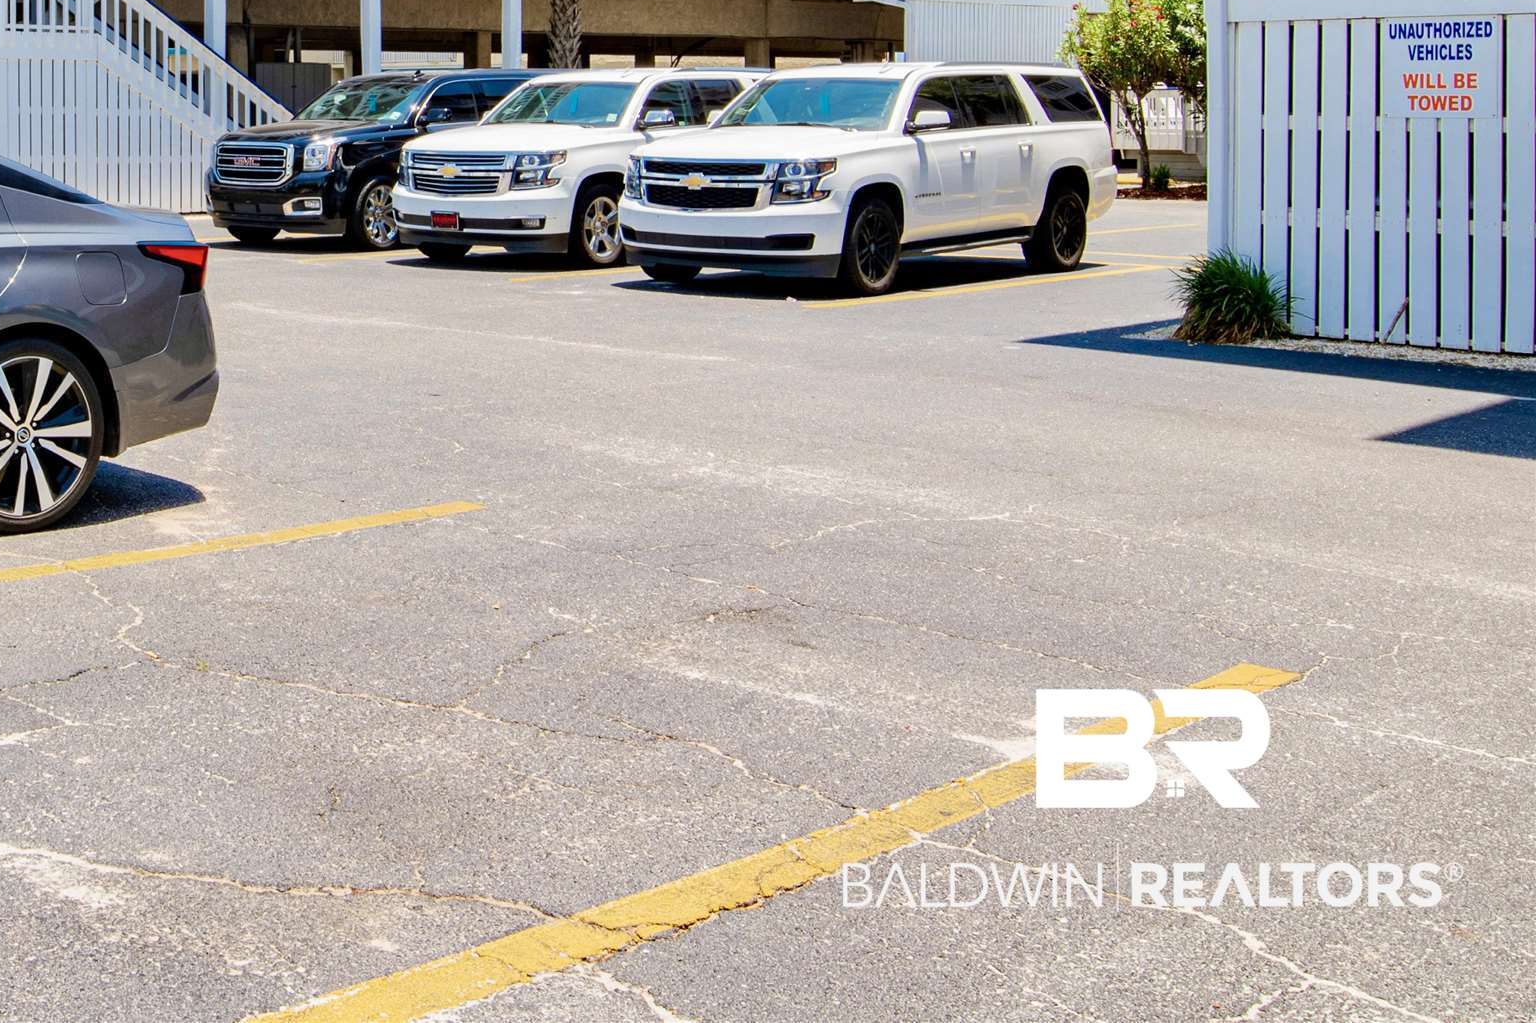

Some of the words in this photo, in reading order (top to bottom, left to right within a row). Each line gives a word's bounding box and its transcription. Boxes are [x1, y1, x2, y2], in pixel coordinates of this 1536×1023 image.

[1388, 21, 1493, 40] UNAUTHORIZED
[1407, 43, 1473, 61] VEHICLES
[1403, 73, 1447, 89] WILL
[1453, 73, 1478, 89] BE
[1407, 95, 1473, 111] TOWED
[234, 157, 261, 167] GMC
